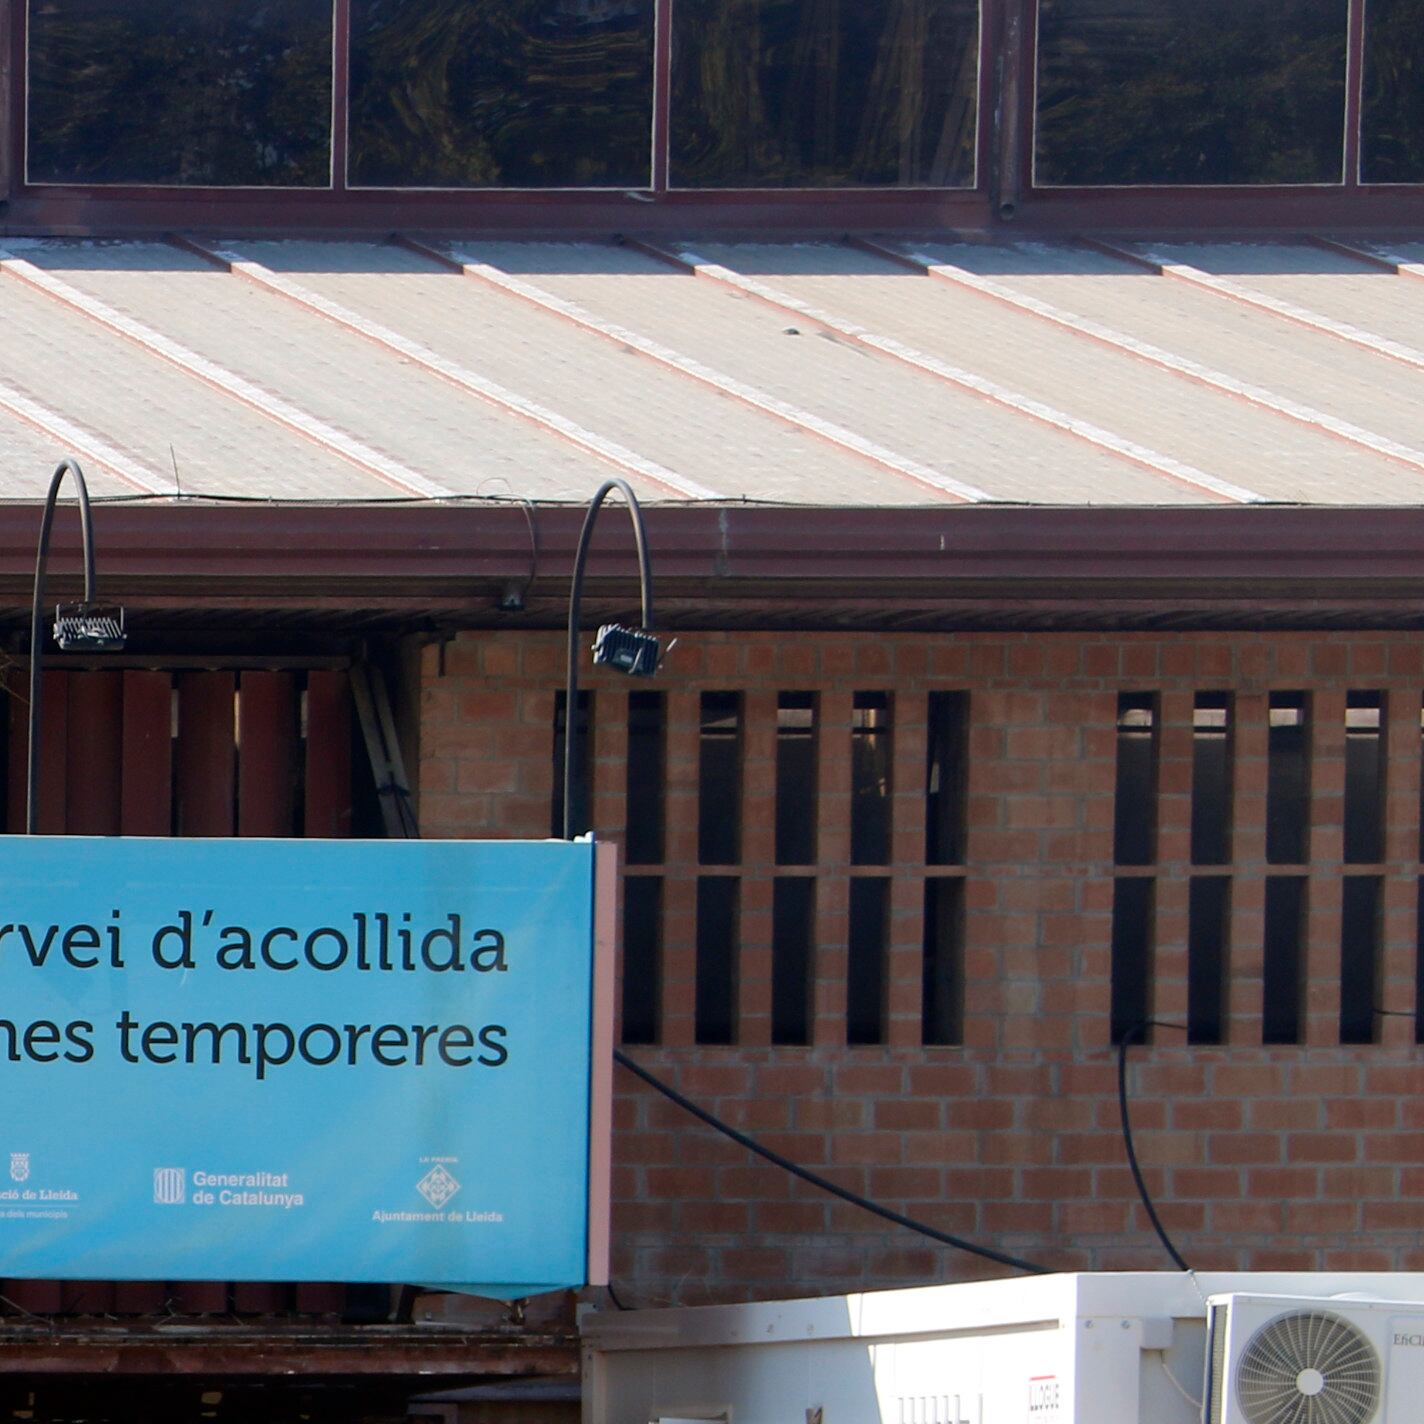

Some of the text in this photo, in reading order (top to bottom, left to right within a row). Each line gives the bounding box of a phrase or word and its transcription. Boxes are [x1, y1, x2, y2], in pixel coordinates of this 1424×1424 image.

[115, 1010, 508, 1079] temporeres
[192, 1171, 289, 1188] Generalitat
[21, 1189, 37, 1201] de
[38, 1189, 79, 1201] Lleida
[192, 1189, 305, 1209] de Catalunya
[372, 1210, 503, 1224] Ajuntament de Lleida
